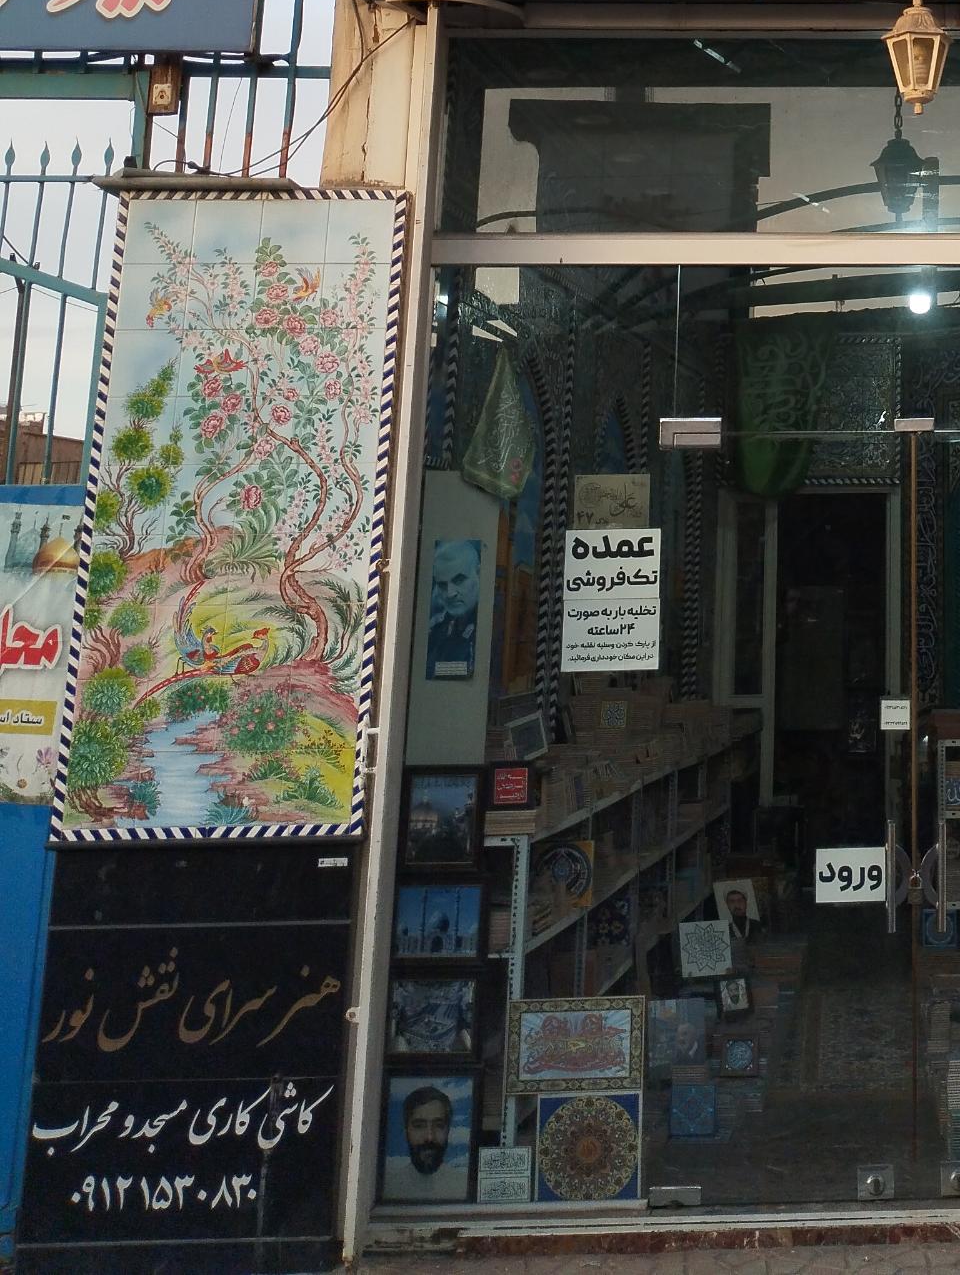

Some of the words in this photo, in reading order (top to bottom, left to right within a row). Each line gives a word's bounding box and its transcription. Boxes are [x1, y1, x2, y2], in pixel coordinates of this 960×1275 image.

[572, 535, 655, 560] عمده
[568, 608, 599, 621] صورت
[601, 607, 612, 620] به
[614, 606, 626, 620] بار
[627, 605, 656, 620] تخلیه
[12, 711, 43, 726] ستاد
[818, 858, 883, 893] ورود
[41, 967, 95, 1044] نور
[96, 946, 181, 1053] نقش
[31, 1099, 121, 1157] محراب
[118, 1111, 136, 1140] و
[138, 1096, 189, 1154] مسجد
[188, 1084, 274, 1146] کاری
[256, 1080, 335, 1149] کاشی
[71, 1174, 133, 1212] ۰۹۱۲
[140, 1174, 258, 1211] ۱۵۳۰۸۳۰
